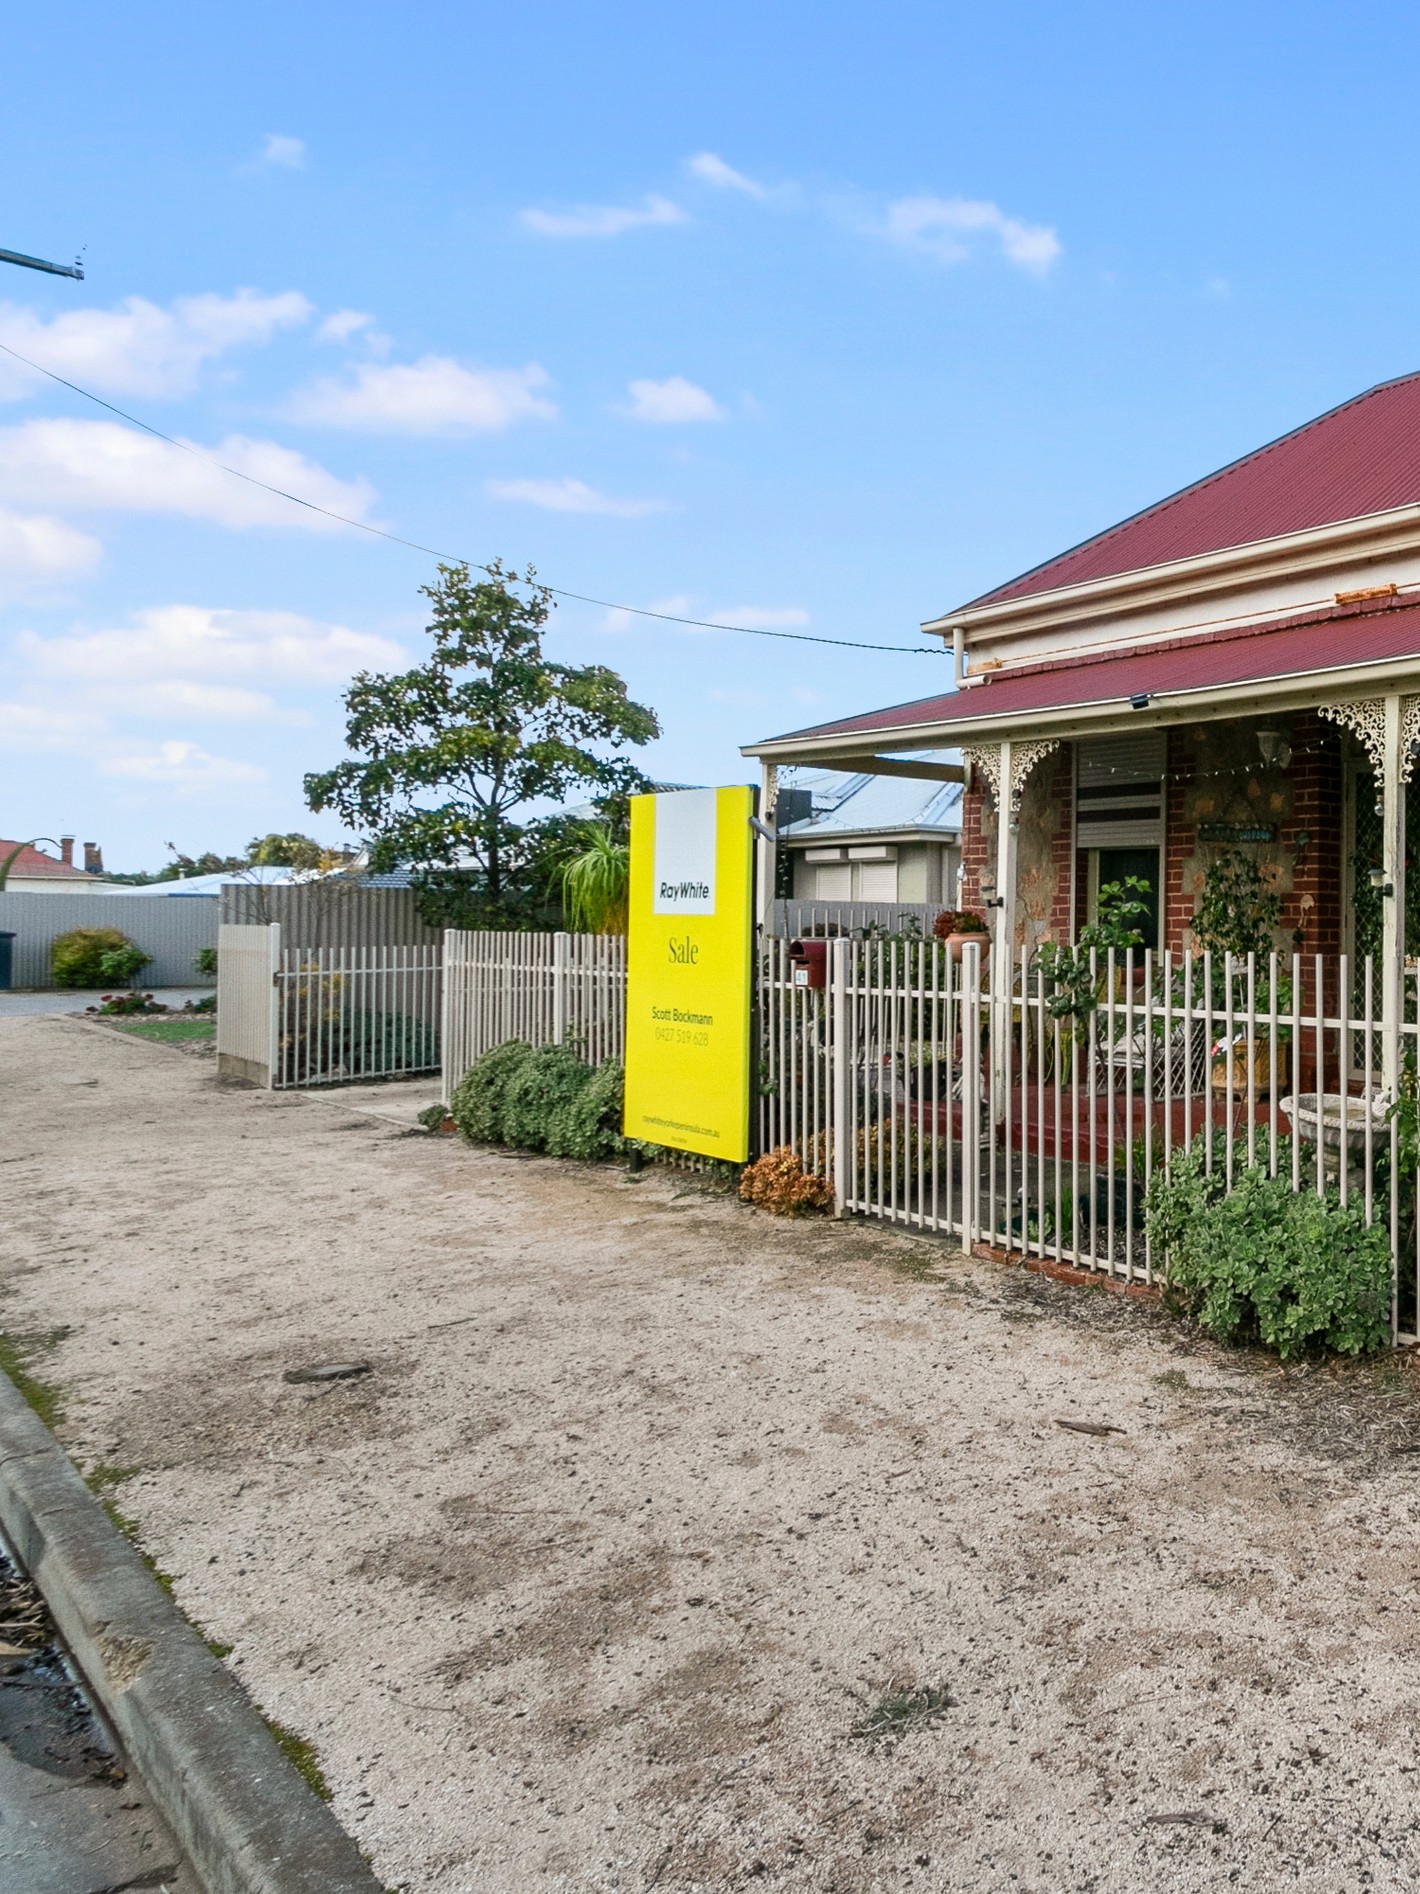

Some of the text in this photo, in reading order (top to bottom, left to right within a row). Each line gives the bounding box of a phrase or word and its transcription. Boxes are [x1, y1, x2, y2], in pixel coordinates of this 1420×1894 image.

[668, 936, 699, 965] Sale
[652, 1006, 713, 1026] Scott Bockmann
[655, 1026, 709, 1047] 0427 519 628
